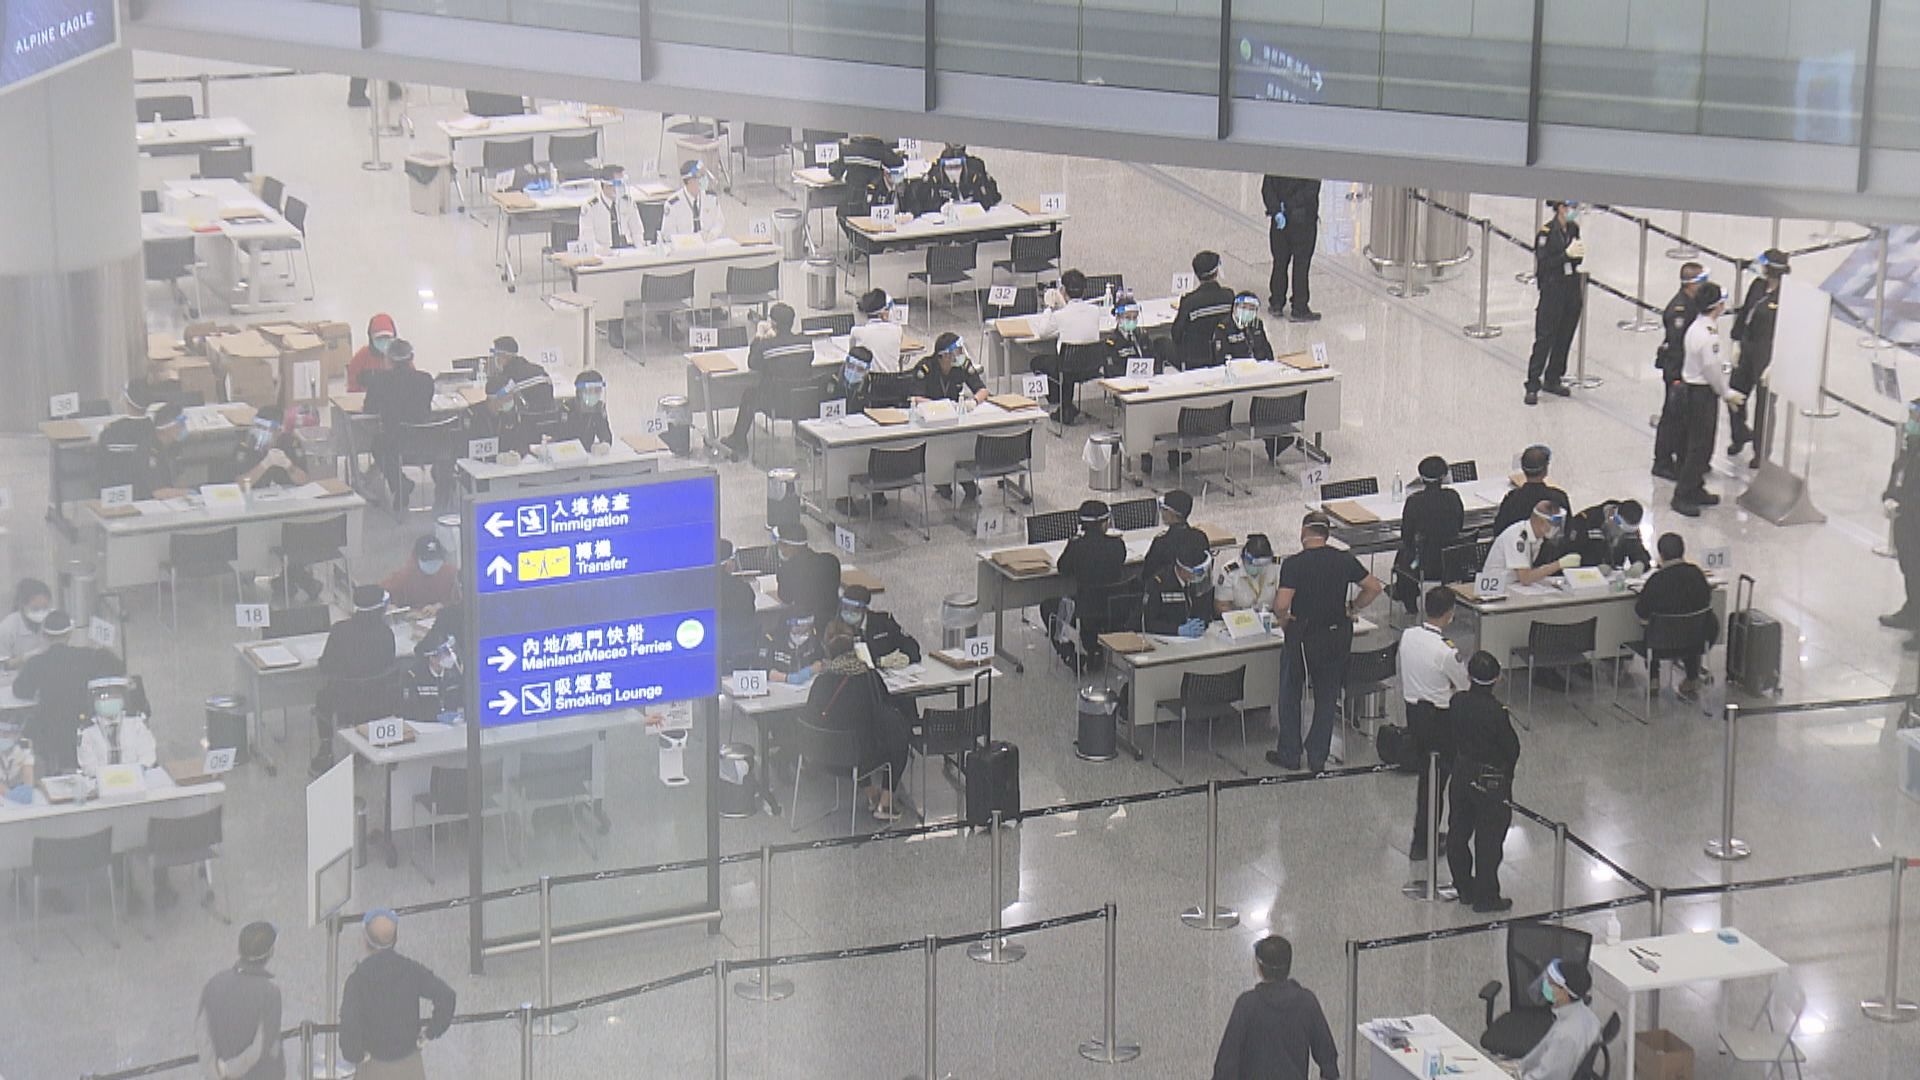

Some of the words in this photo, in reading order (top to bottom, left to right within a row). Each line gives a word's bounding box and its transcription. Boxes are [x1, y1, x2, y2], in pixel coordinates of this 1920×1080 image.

[15, 25, 55, 55] ALPINE
[59, 10, 96, 38] EAGLE
[820, 148, 834, 158] 47
[1045, 198, 1059, 208] 41
[876, 209, 890, 219] 42
[754, 222, 767, 234] 43
[573, 243, 588, 254] 44
[1177, 277, 1188, 289] 31
[995, 288, 1011, 299] 32
[695, 332, 710, 344] 34
[541, 351, 557, 363] 35
[1132, 362, 1148, 374] 22
[1028, 381, 1043, 393] 23
[825, 404, 840, 416] 24
[647, 418, 662, 432] 25
[475, 442, 492, 455] 26
[1307, 470, 1322, 484] 12
[551, 492, 630, 519] 入境檢查
[551, 513, 629, 533] Immigration
[984, 519, 997, 532] 14
[839, 534, 851, 549] 15
[575, 555, 628, 575] Transfer
[1707, 553, 1723, 565] 01
[1480, 578, 1499, 591] 02
[245, 608, 263, 622] 18
[522, 647, 627, 671] Mainland/Macao
[631, 640, 673, 657] Ferries
[971, 642, 989, 657] 05
[554, 672, 612, 695] 吸煙室
[740, 676, 759, 690] 06
[555, 691, 611, 711] Smoking
[615, 684, 663, 702] Lounge
[376, 724, 396, 739] 08
